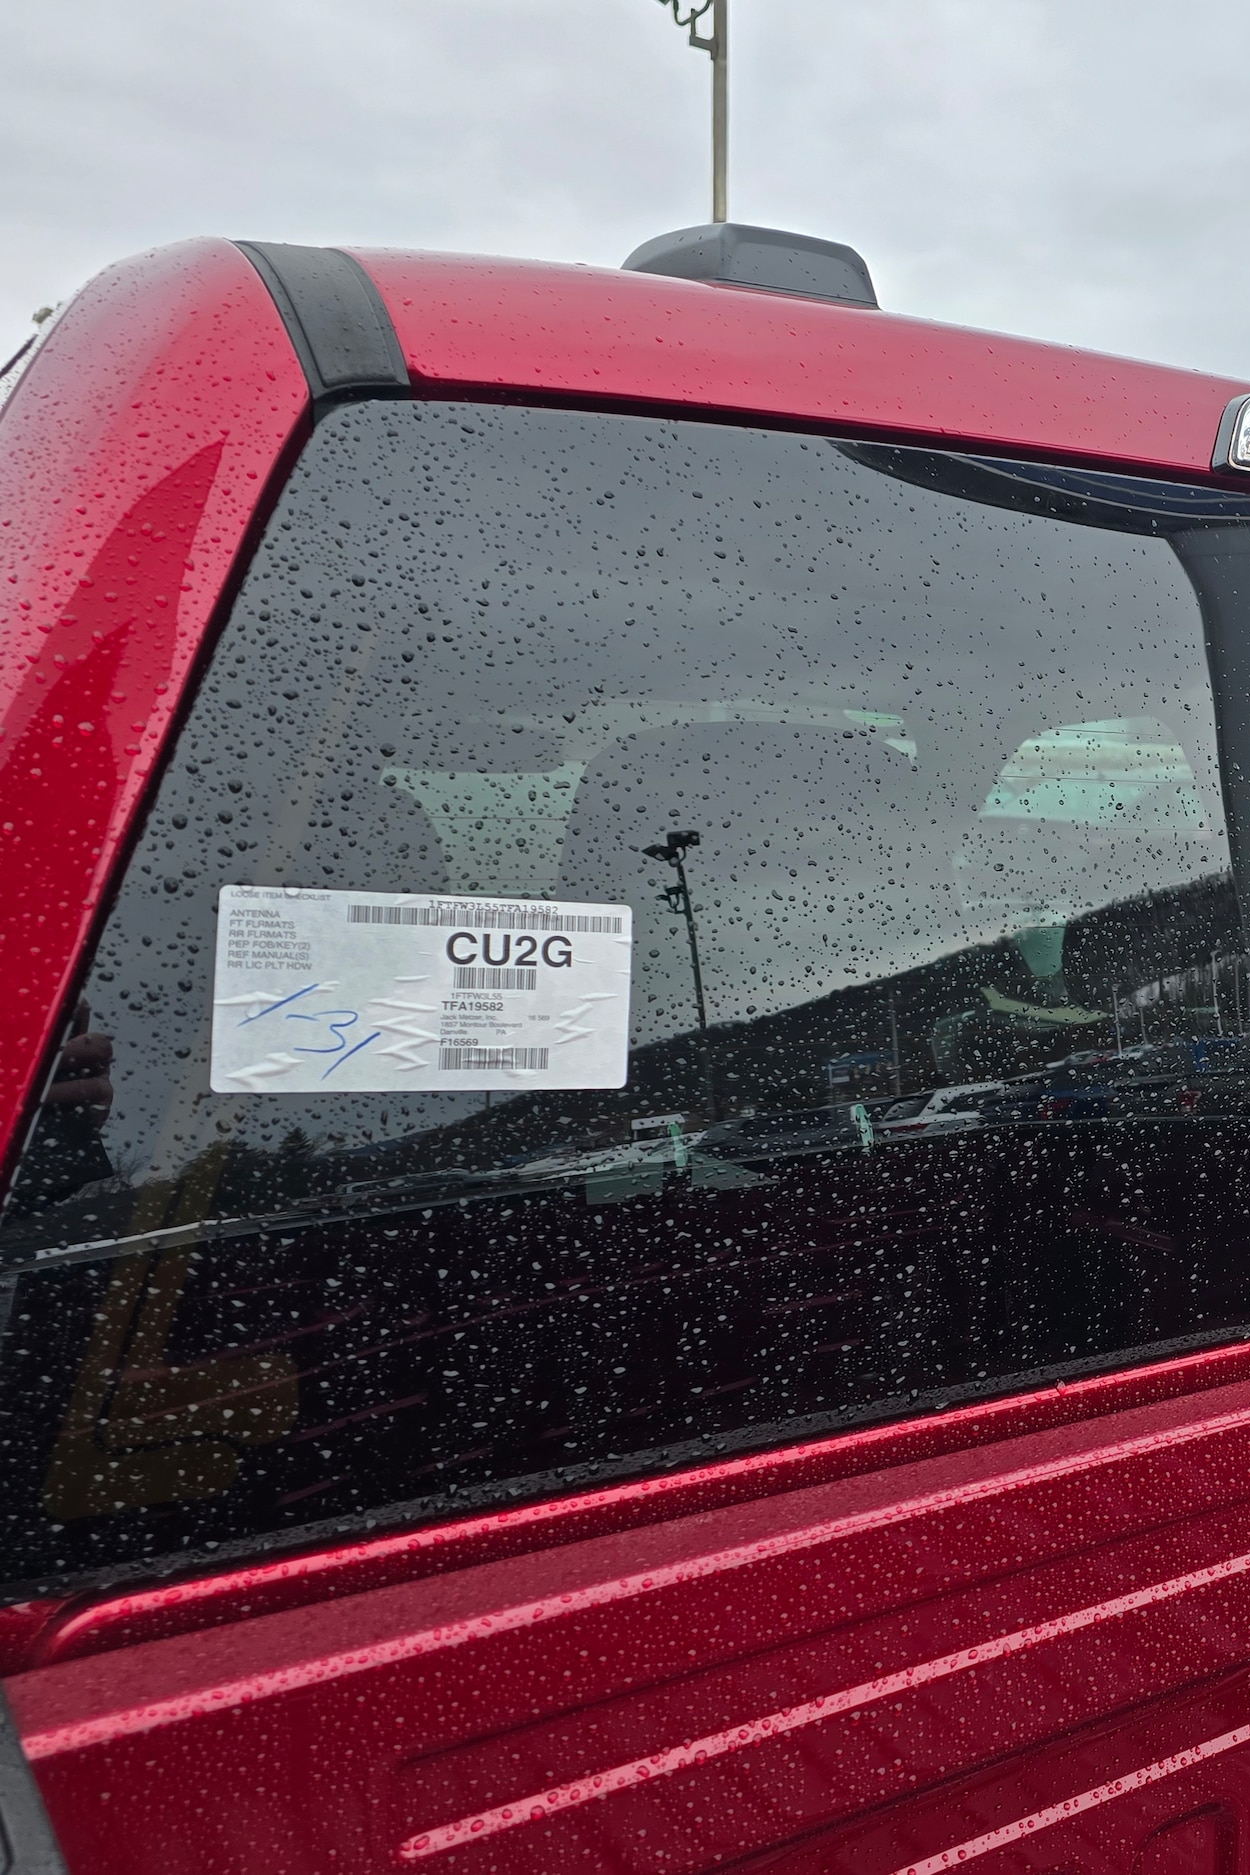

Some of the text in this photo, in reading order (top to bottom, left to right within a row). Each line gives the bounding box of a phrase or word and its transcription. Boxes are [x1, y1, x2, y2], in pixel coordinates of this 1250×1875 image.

[231, 891, 260, 899] LOOSE
[429, 900, 558, 915] 1FTFW3L55TFA19582
[230, 909, 281, 919] ANTENNA
[229, 919, 243, 927] FT
[229, 929, 244, 938] RR
[228, 940, 311, 951] PEP FOB/KEY(2)
[446, 931, 573, 968] CU2G
[228, 950, 309, 962] REF MANUAL(S)
[227, 961, 312, 970] RR LIC PLT HDW
[441, 1001, 504, 1011] TFA19582
[440, 1038, 479, 1046] F16569
